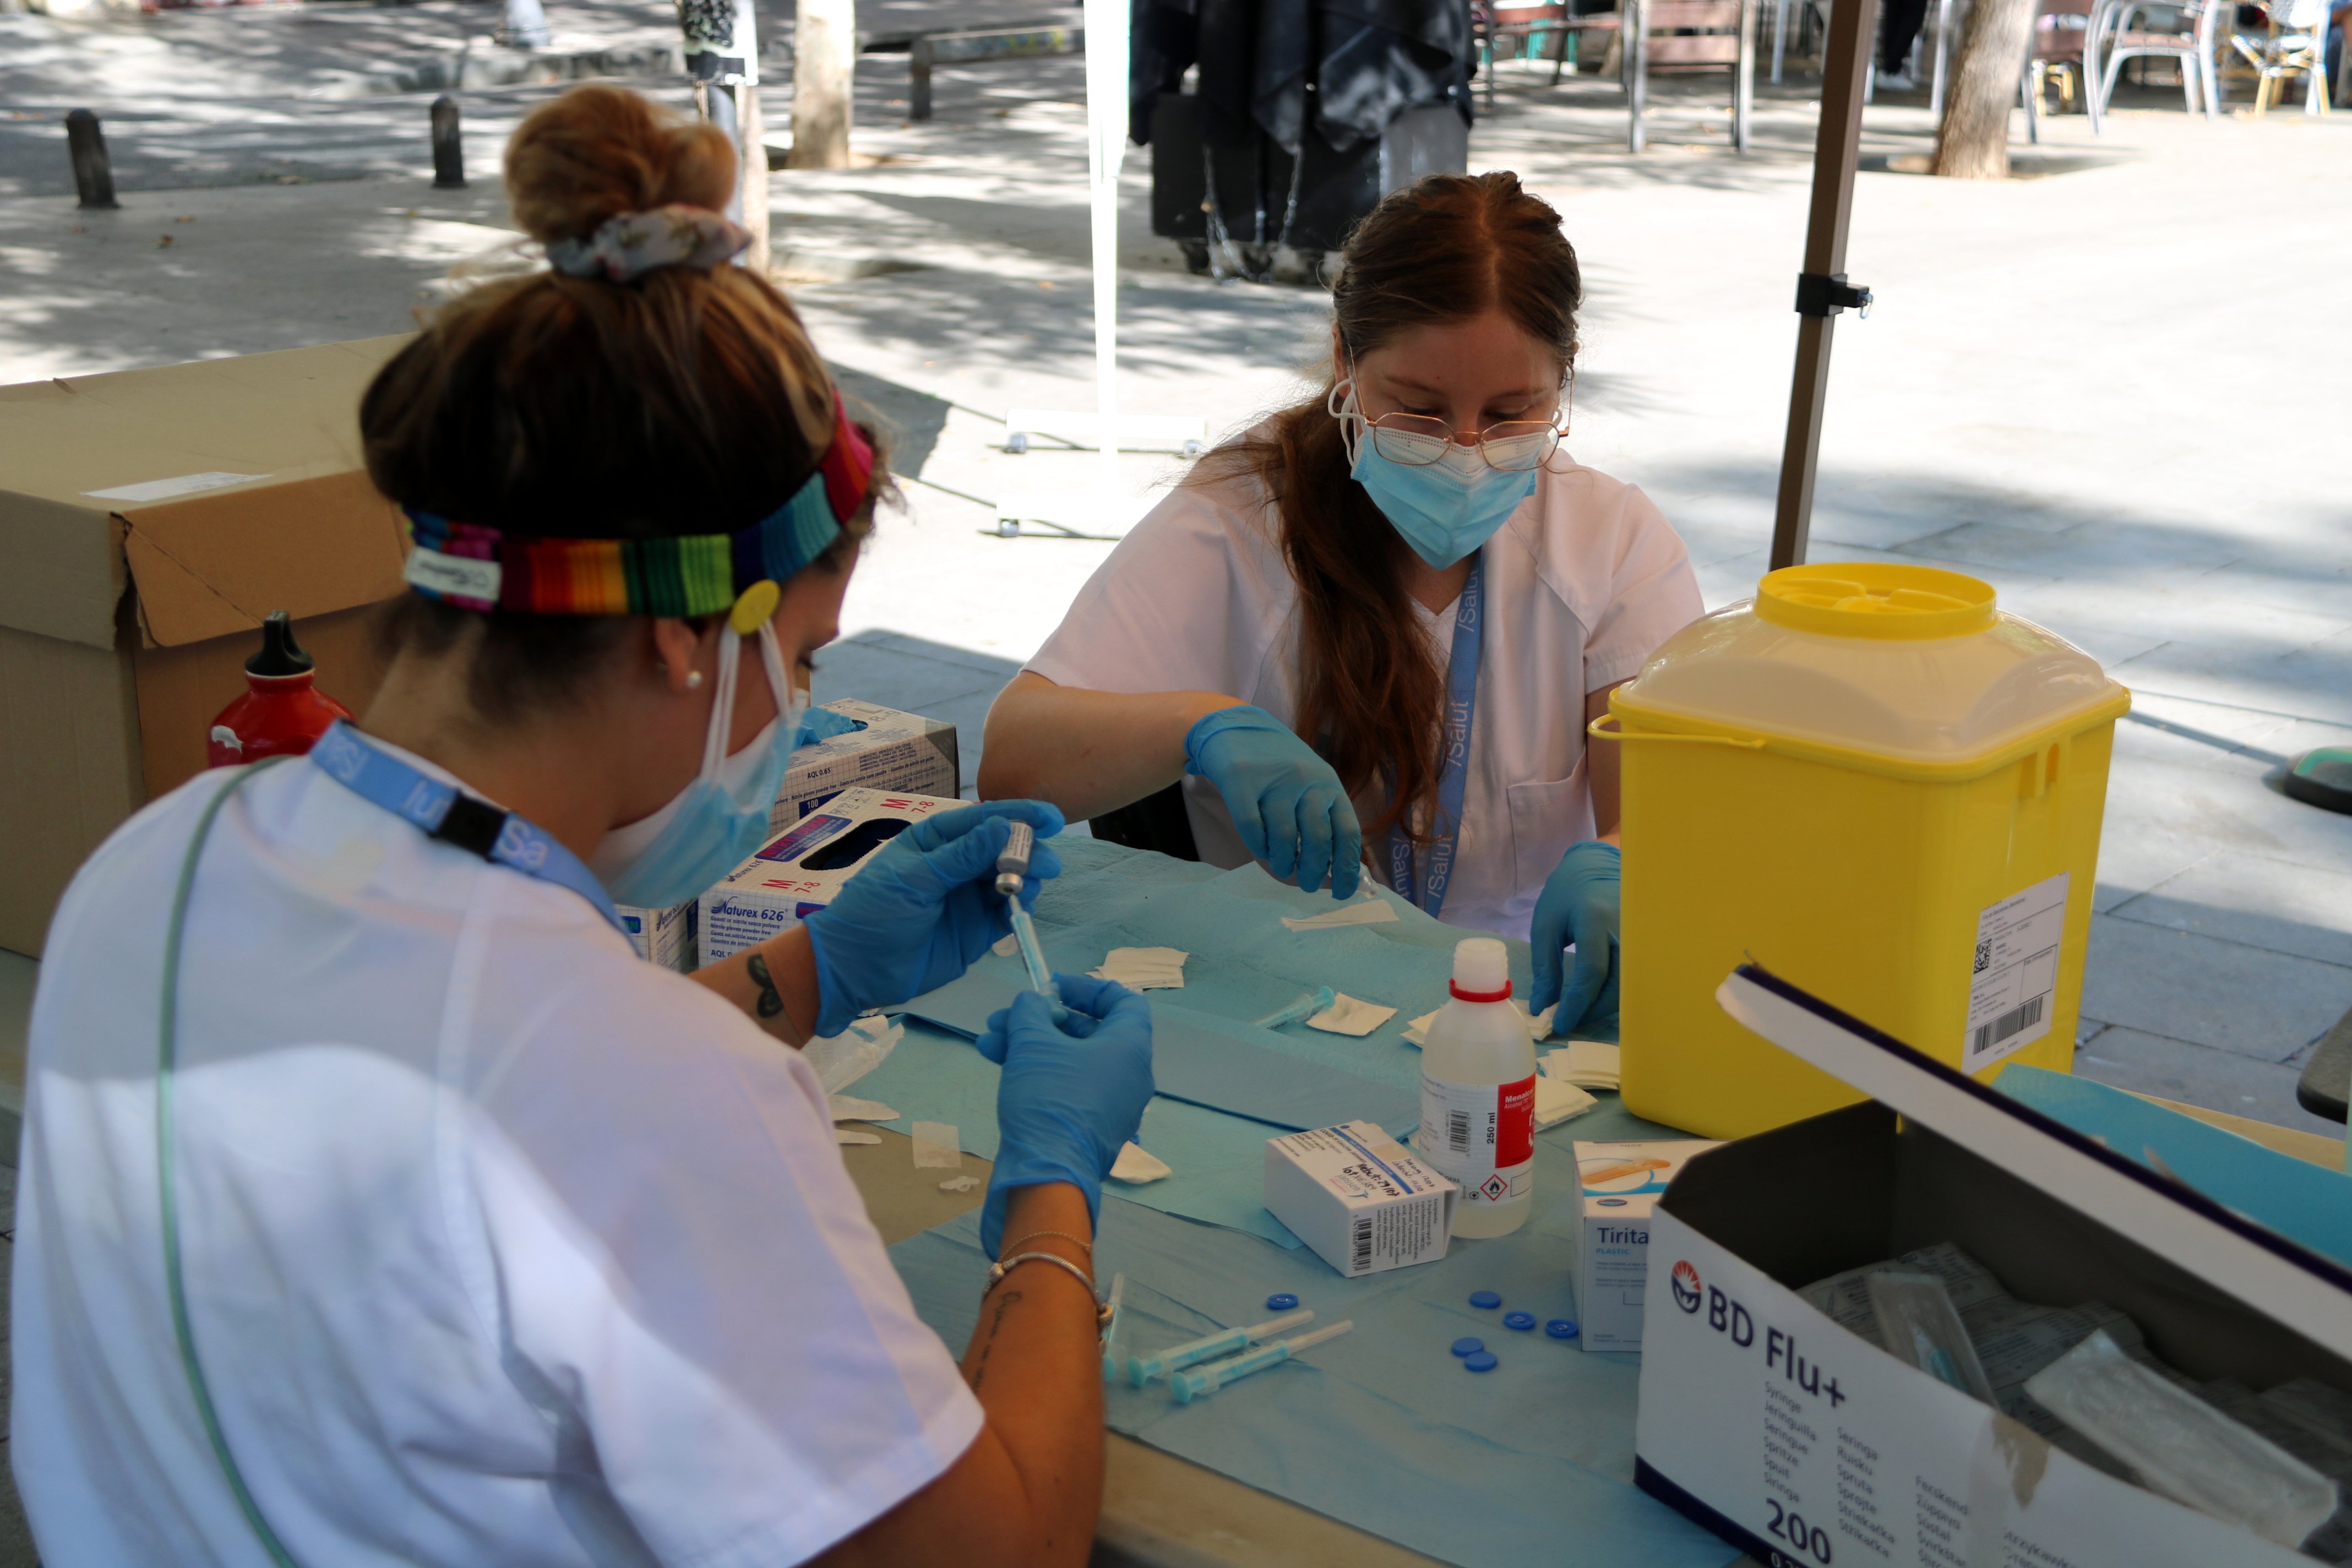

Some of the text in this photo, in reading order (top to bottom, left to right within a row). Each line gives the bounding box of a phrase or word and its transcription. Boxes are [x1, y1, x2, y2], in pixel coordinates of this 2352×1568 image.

[1458, 568, 1479, 633] /Salut
[1447, 700, 1469, 767] /Salut
[807, 767, 831, 780] AQL 0.65
[807, 799, 819, 809] 100
[879, 798, 913, 810] M
[910, 801, 935, 813] 7-8
[792, 815, 832, 836] DERM
[749, 859, 764, 868] 626
[760, 878, 798, 889] M
[794, 881, 821, 893] 7-8
[710, 896, 757, 918] Naturex
[710, 915, 726, 923] Guanti
[742, 926, 761, 934] powder
[711, 949, 726, 958] AQL
[1504, 1099, 1523, 1109] Alcohol
[1505, 1086, 1534, 1103] Menalcol
[1487, 1112, 1495, 1144] 250 ml
[1320, 1129, 1339, 1141] COVID-19
[1350, 1151, 1366, 1163] Janssen
[1334, 1174, 1360, 1191] janssen
[1708, 1283, 1754, 1347] BD
[1766, 1325, 1846, 1408] Flu+
[1765, 1381, 1801, 1413] Syringe
[1765, 1401, 1816, 1442] Jeringuilla
[1764, 1417, 1809, 1455] Seringue
[1837, 1427, 1877, 1461] Seringa
[1764, 1436, 1799, 1466] Spritze
[1837, 1445, 1872, 1476] Ruisku
[1764, 1454, 1789, 1479] Spuit
[1764, 1472, 1799, 1502] Siringa
[1837, 1464, 1872, 1495] Spruta
[1916, 1475, 1969, 1516] Fecskend
[1766, 1498, 1831, 1565] 200
